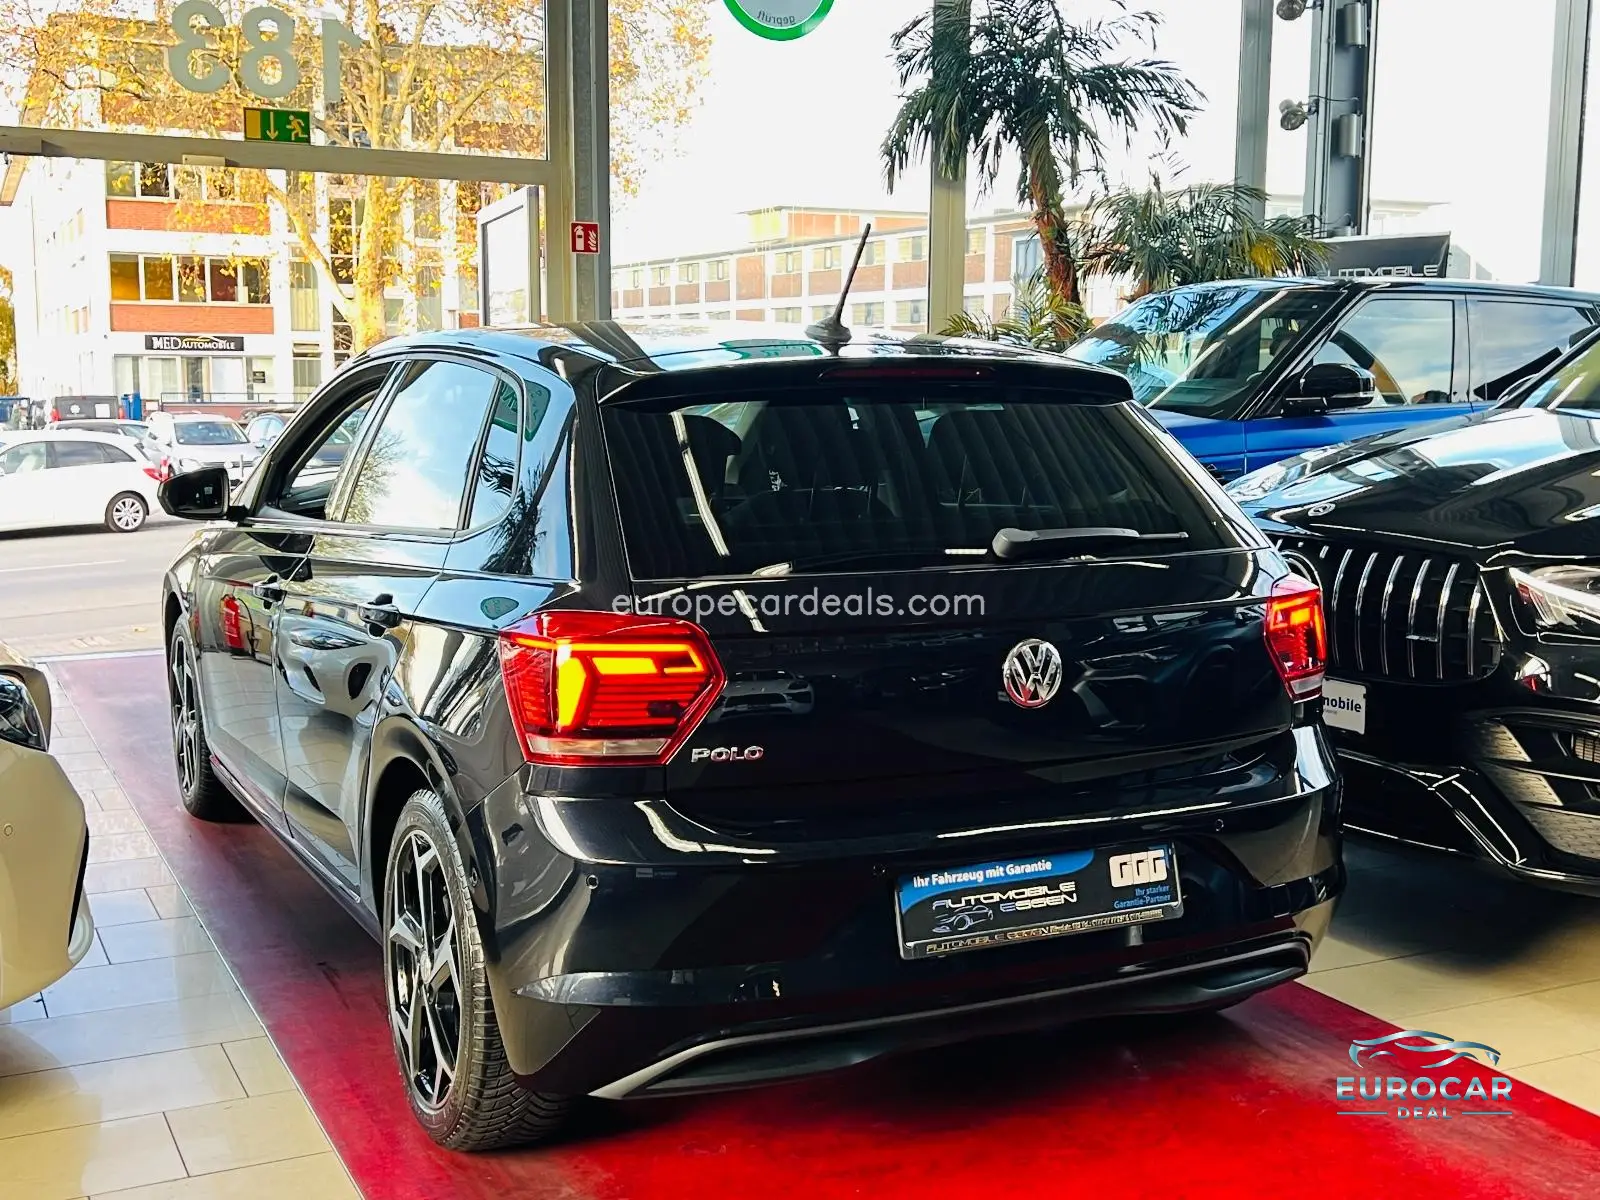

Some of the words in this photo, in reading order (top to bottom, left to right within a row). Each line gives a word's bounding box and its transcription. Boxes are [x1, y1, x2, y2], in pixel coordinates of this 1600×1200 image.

[691, 745, 764, 763] POLO
[913, 876, 930, 888] Ihr
[931, 870, 984, 883] Fahrzeug
[985, 865, 1005, 877] mit
[1006, 860, 1053, 875] Garantie
[932, 881, 1076, 911] AUTOMOBILE
[1113, 894, 1171, 909] Garantie-Partner
